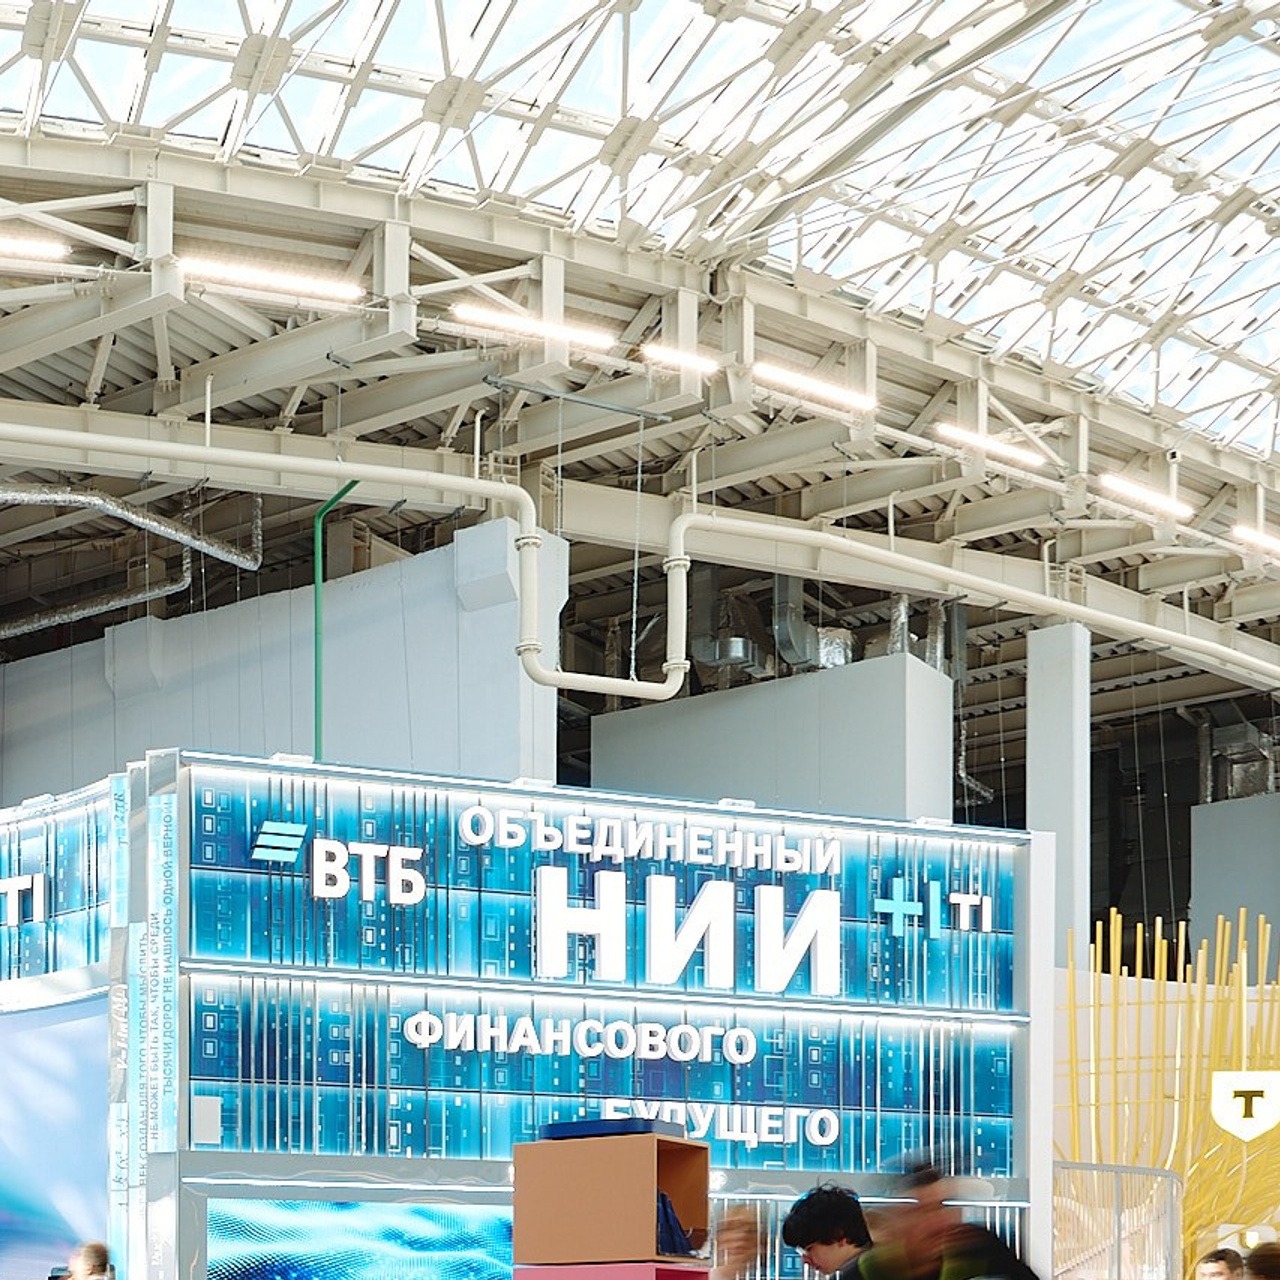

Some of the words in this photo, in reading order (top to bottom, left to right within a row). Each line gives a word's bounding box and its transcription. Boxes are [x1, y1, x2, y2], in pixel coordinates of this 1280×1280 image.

[458, 805, 841, 875] ОБЪЕДИНЕННЫЙ
[161, 861, 174, 905] ОДНОЙ
[312, 838, 427, 906] ВТБ
[150, 912, 160, 955] СРЕДИ
[162, 909, 174, 973] НАШЛОСЬ
[535, 865, 841, 997] НИИ
[150, 958, 159, 1003] ЧТОБЫ
[162, 976, 173, 993] НЕ
[150, 1005, 160, 1031] ТАК,
[162, 995, 174, 1039] ДОРОГ
[404, 1010, 758, 1065] ФИНАНСОВОГО
[150, 1036, 159, 1072] БЫТЬ
[162, 1042, 173, 1095] ТЫСЯЧИ
[150, 1075, 159, 1120] МОЖЕТ
[150, 1121, 159, 1140] НЕ
